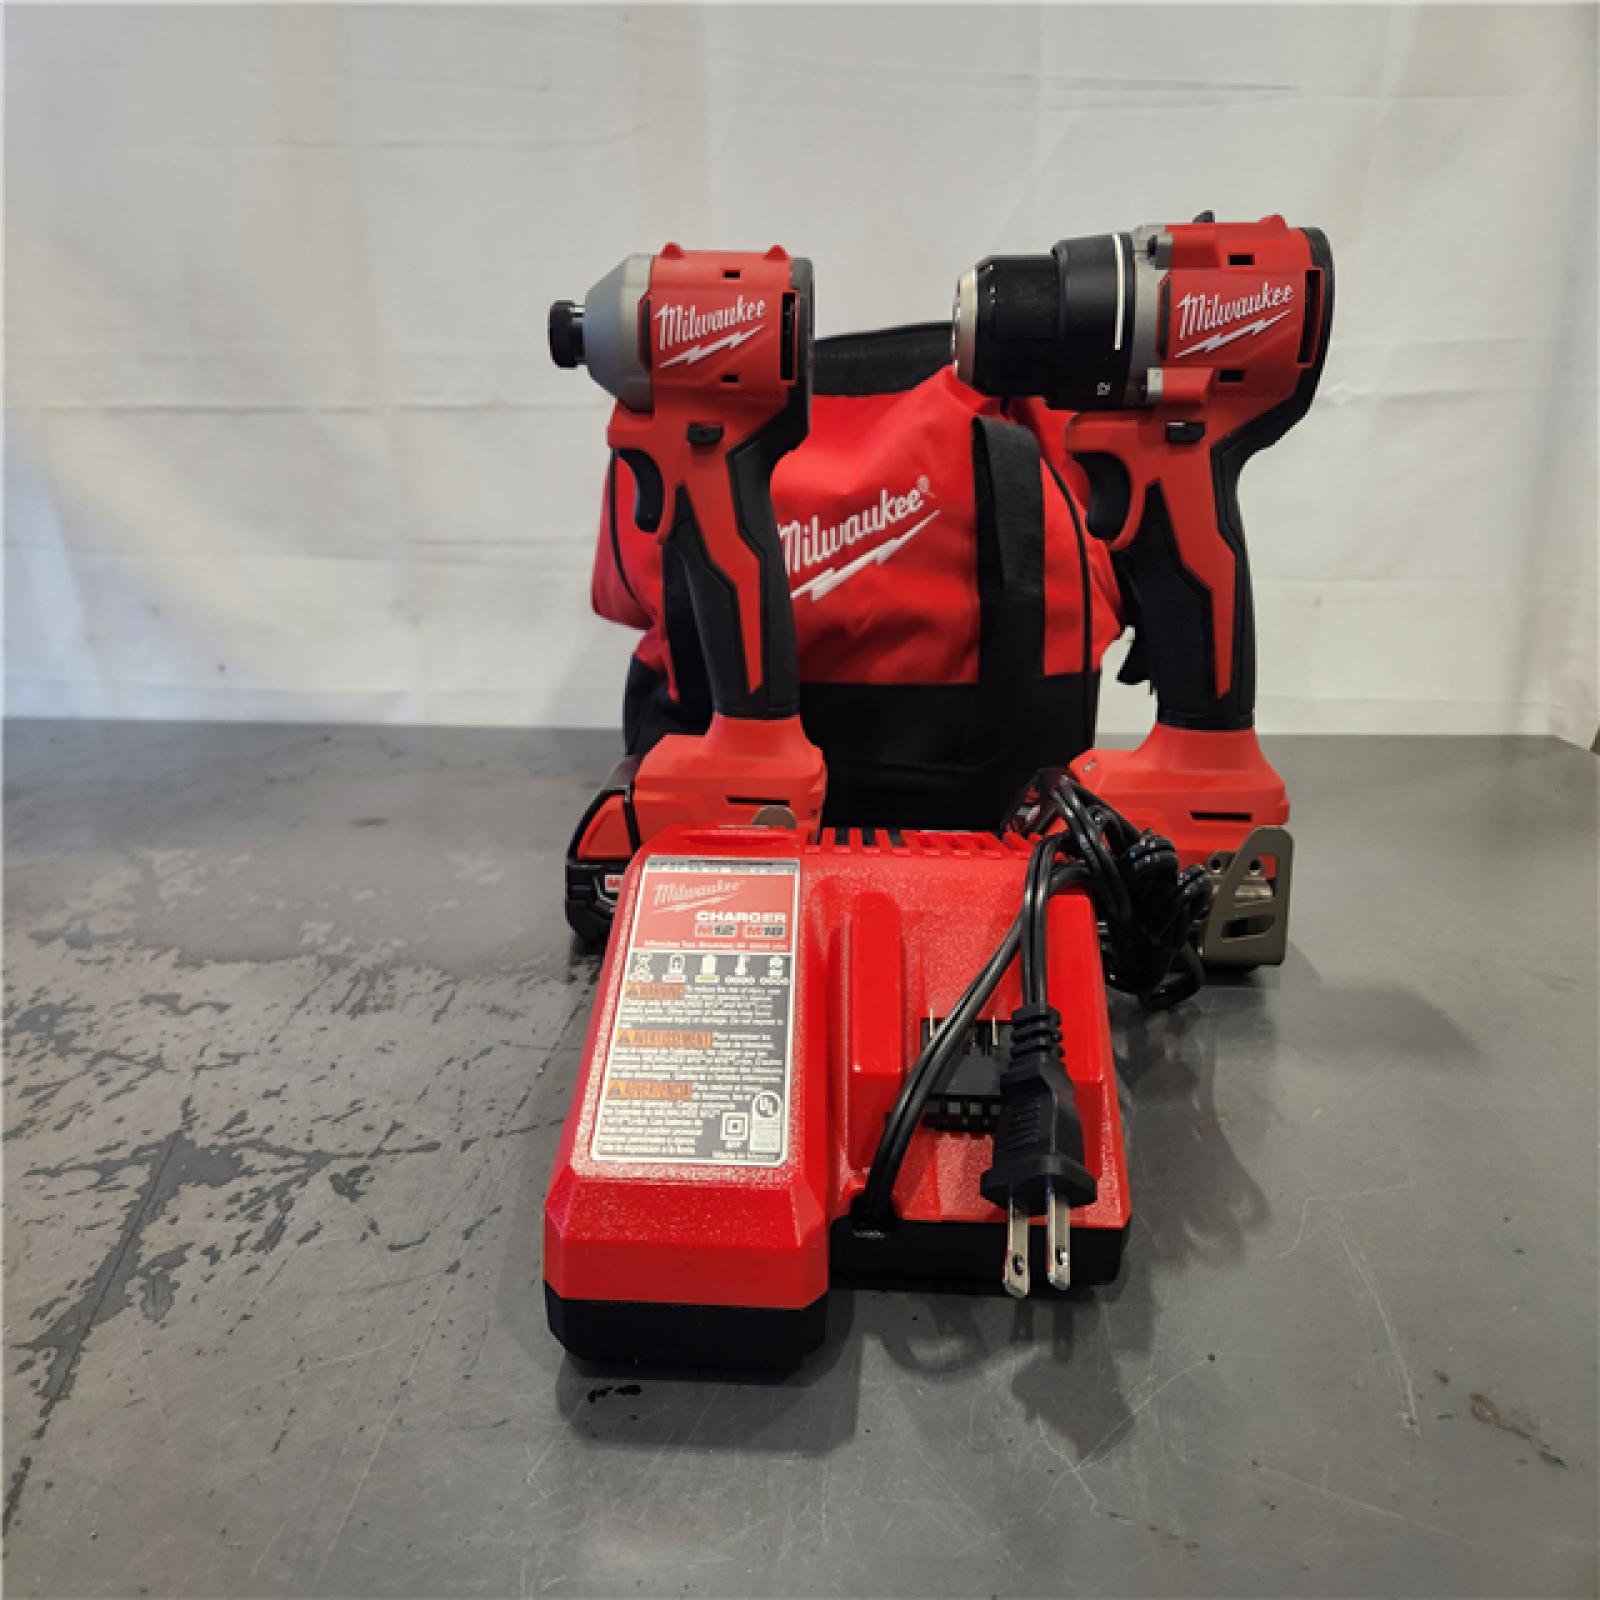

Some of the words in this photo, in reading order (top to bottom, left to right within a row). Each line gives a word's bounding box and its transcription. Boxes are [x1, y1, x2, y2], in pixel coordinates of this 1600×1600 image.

[655, 295, 766, 351] Milwaukee
[1176, 281, 1293, 340] Milwaukee
[654, 879, 741, 905] Milwaukee
[696, 911, 786, 923] CHARGER
